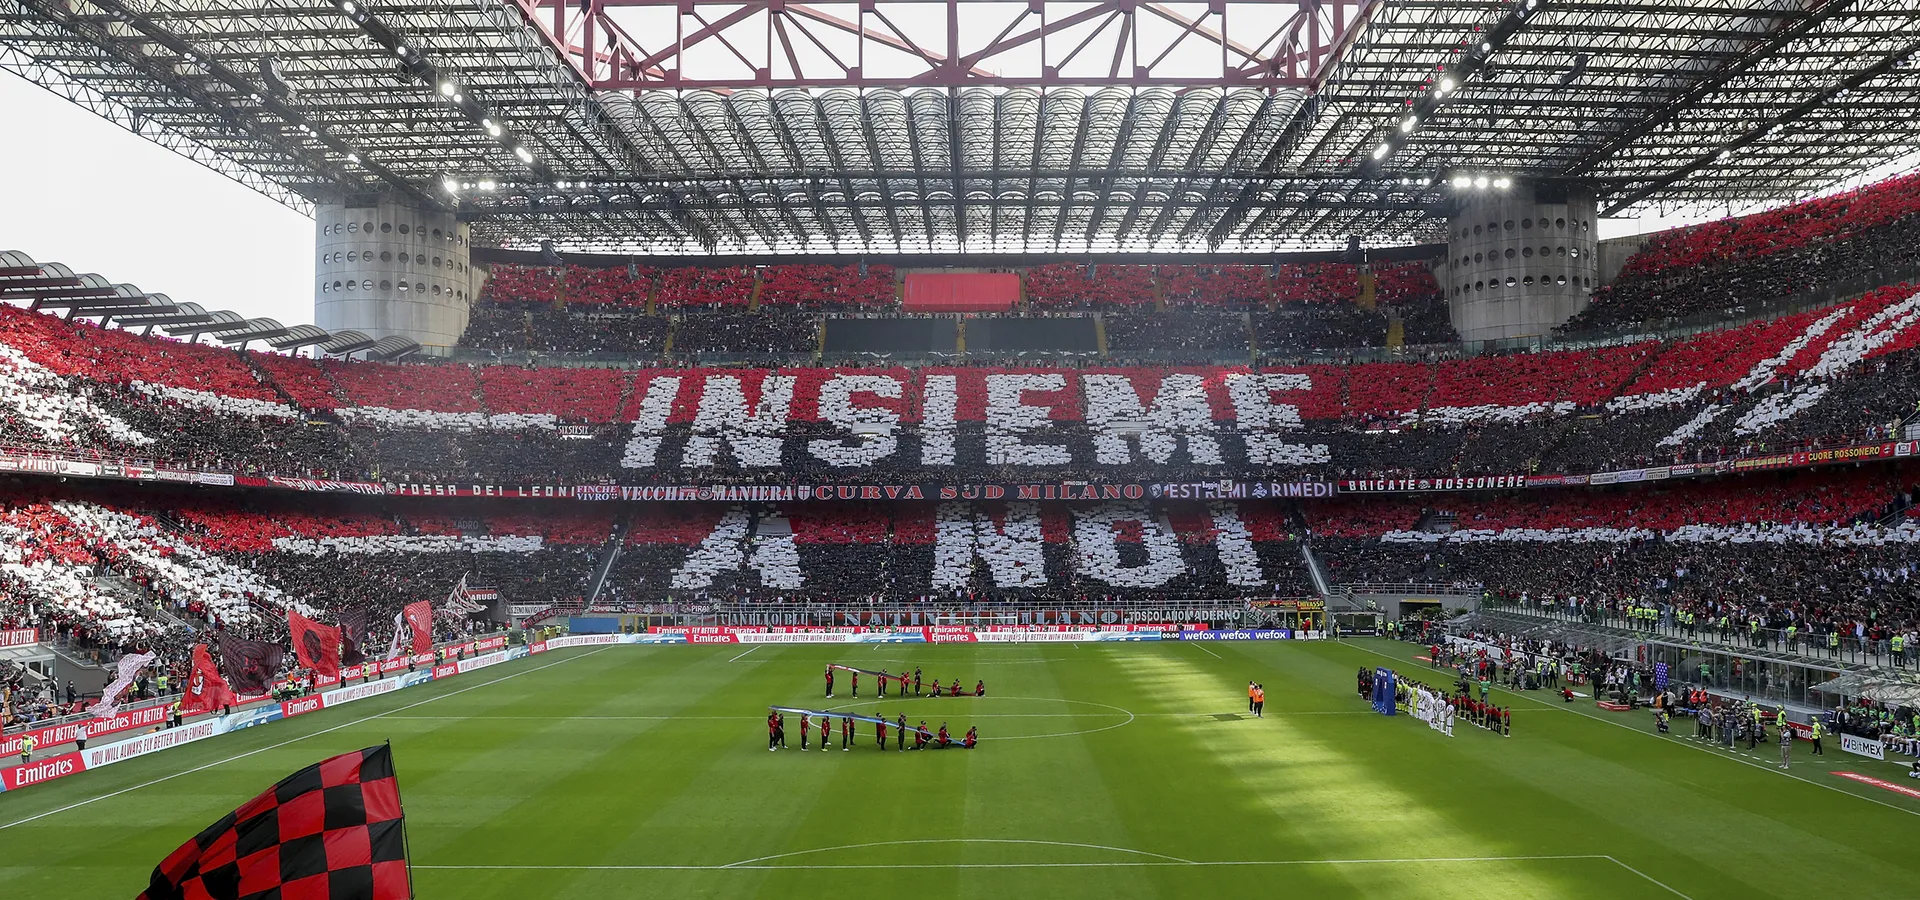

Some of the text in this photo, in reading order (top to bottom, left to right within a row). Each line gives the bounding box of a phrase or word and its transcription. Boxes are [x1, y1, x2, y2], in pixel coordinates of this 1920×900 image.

[620, 373, 1329, 469] INSIEME
[1808, 446, 1880, 461] CUORE ROSSONERO
[400, 484, 574, 497] FOSSA DEI LEONI
[1271, 482, 1332, 497] RIMEDI
[1348, 479, 1415, 490] BRIGATE
[1435, 476, 1524, 490] ROSSONERE
[712, 486, 794, 500] MANIERA
[815, 485, 924, 500] CURVA
[1017, 484, 1144, 500] MILANO
[671, 501, 1266, 589] A NOI
[11, 630, 34, 644] BETTER
[694, 634, 730, 642] Emirates
[1184, 631, 1215, 640] wefox
[1220, 631, 1250, 640] wefox
[1255, 631, 1286, 640] wefox
[436, 666, 456, 678] Emirates
[288, 698, 318, 716] Emirates
[132, 712, 142, 726] FLY
[143, 707, 164, 723] BETTER
[42, 729, 54, 744] FLY
[92, 723, 213, 766] YOU WILL ALWAYS FLY BETTER WITH EMIRATES
[1852, 741, 1882, 756] BitMEX
[16, 759, 72, 786] Emirates
